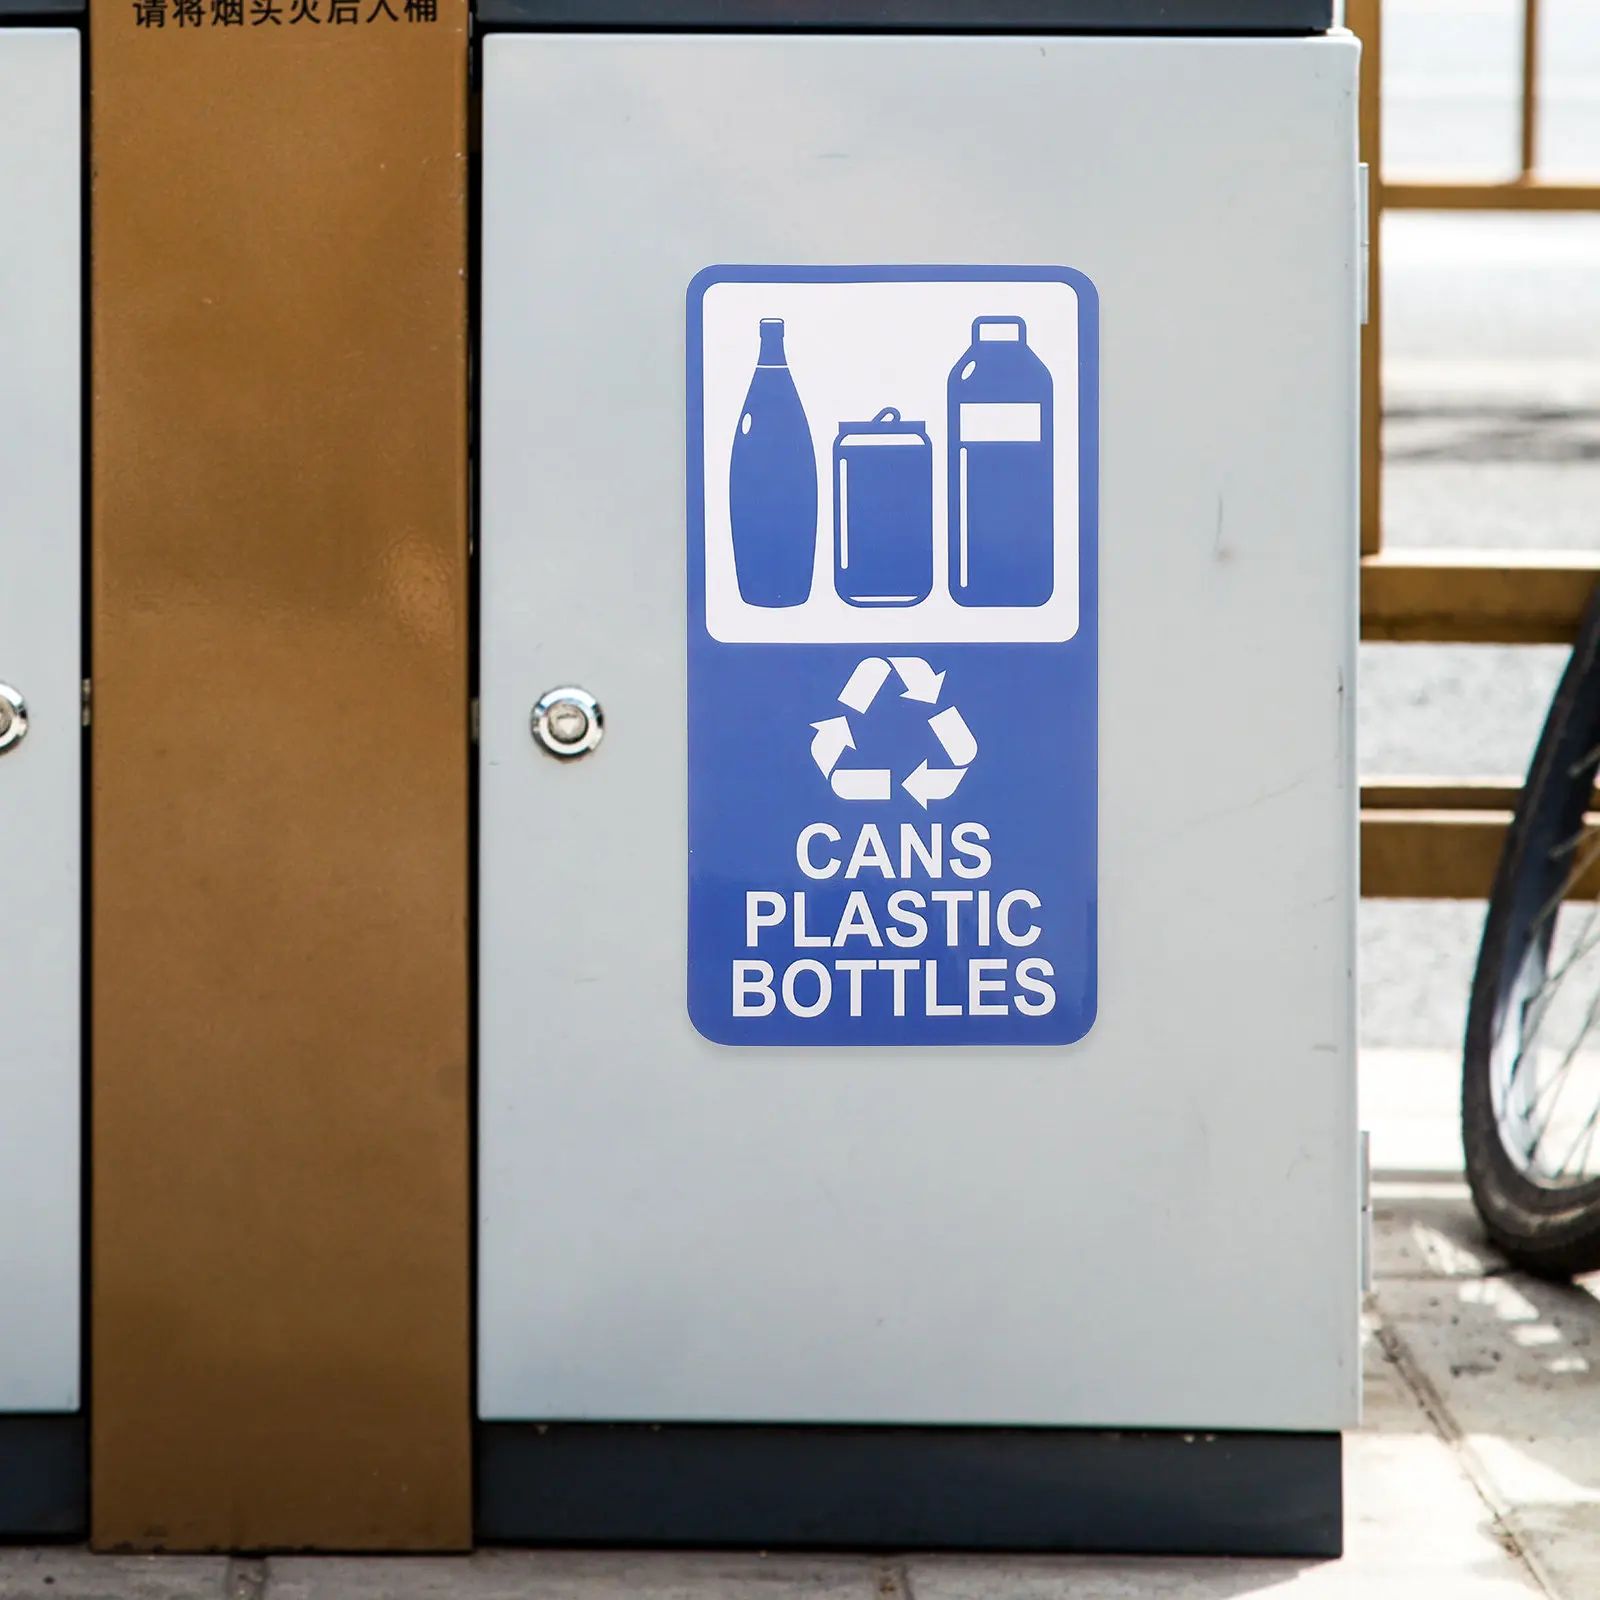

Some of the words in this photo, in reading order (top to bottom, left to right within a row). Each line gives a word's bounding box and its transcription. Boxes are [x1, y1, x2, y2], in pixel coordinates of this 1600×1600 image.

[796, 822, 992, 880] CANS
[746, 889, 1042, 948] PLASTIC
[732, 957, 1056, 1018] BOTTLES
